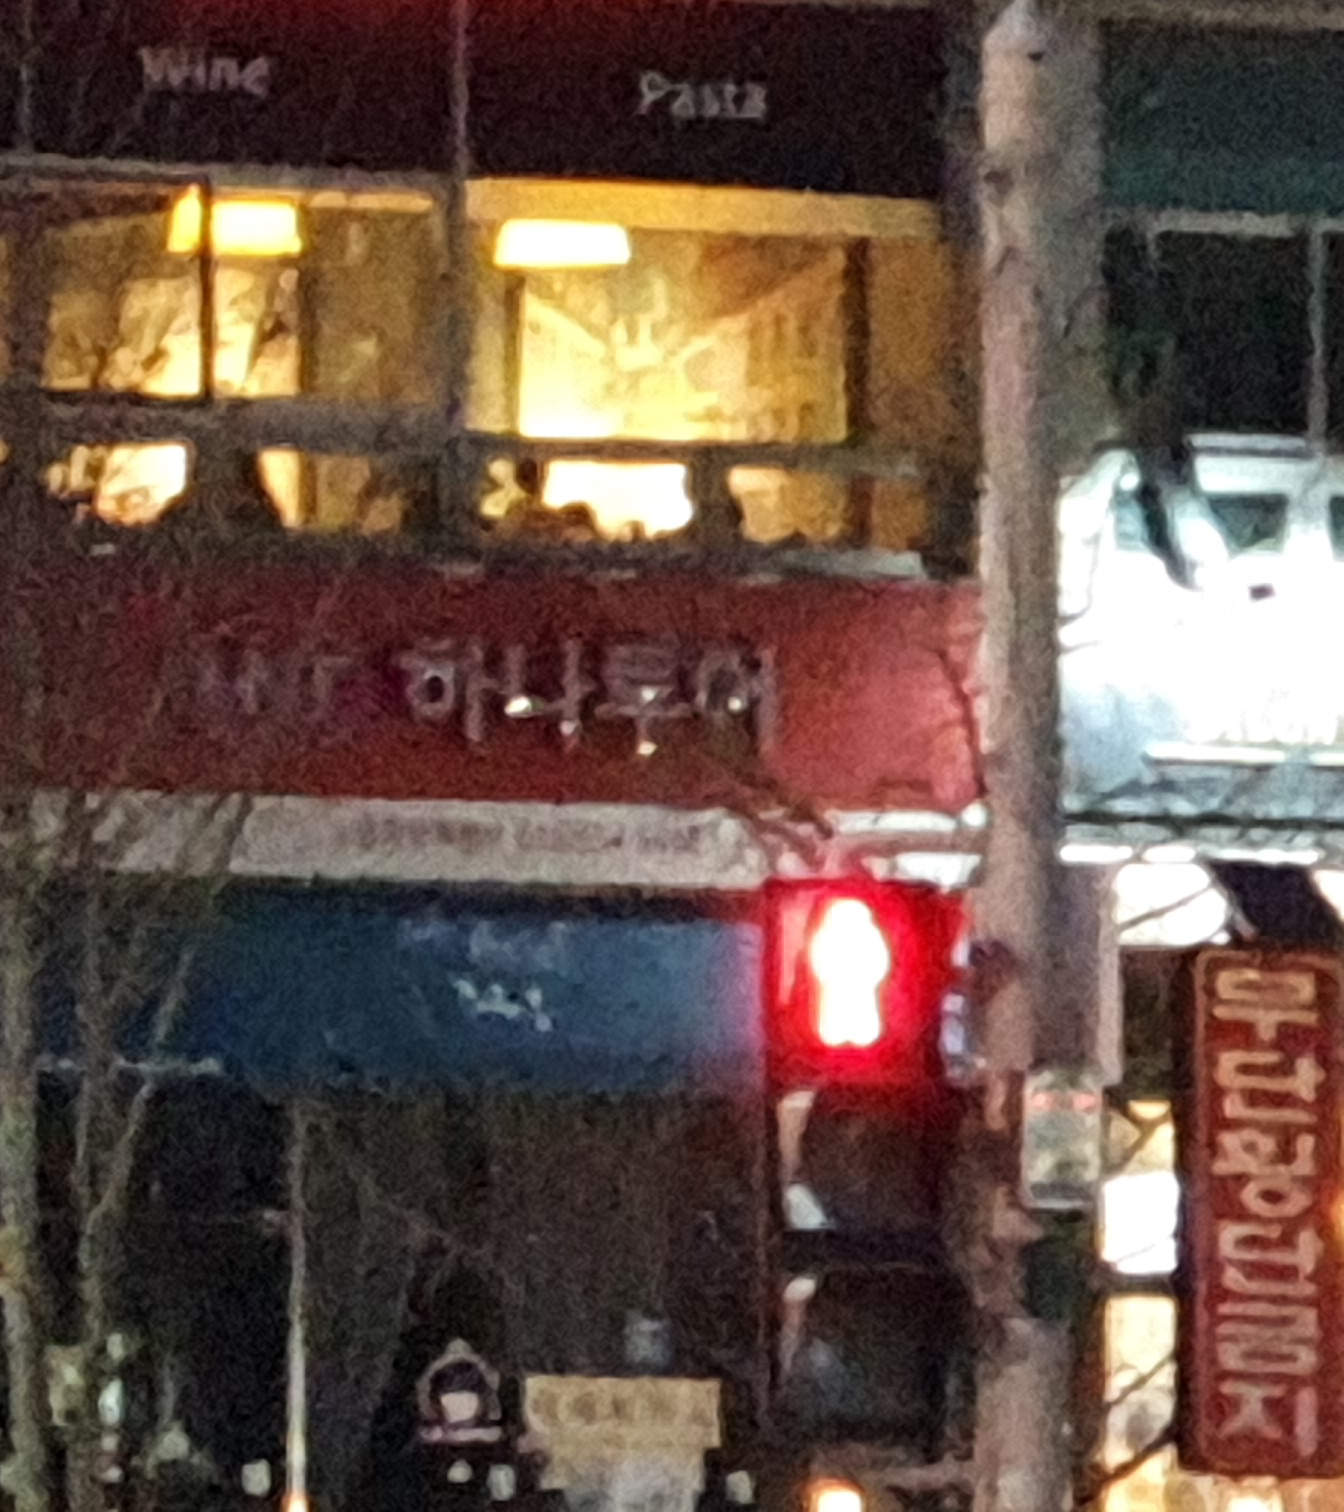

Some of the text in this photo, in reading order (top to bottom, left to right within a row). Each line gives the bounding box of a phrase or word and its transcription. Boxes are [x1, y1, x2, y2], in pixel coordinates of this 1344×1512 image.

[140, 45, 272, 95] Wine
[636, 68, 769, 121] Pasta
[398, 635, 777, 746] 하나투어
[1212, 967, 1325, 1458] 무단횡단금지
